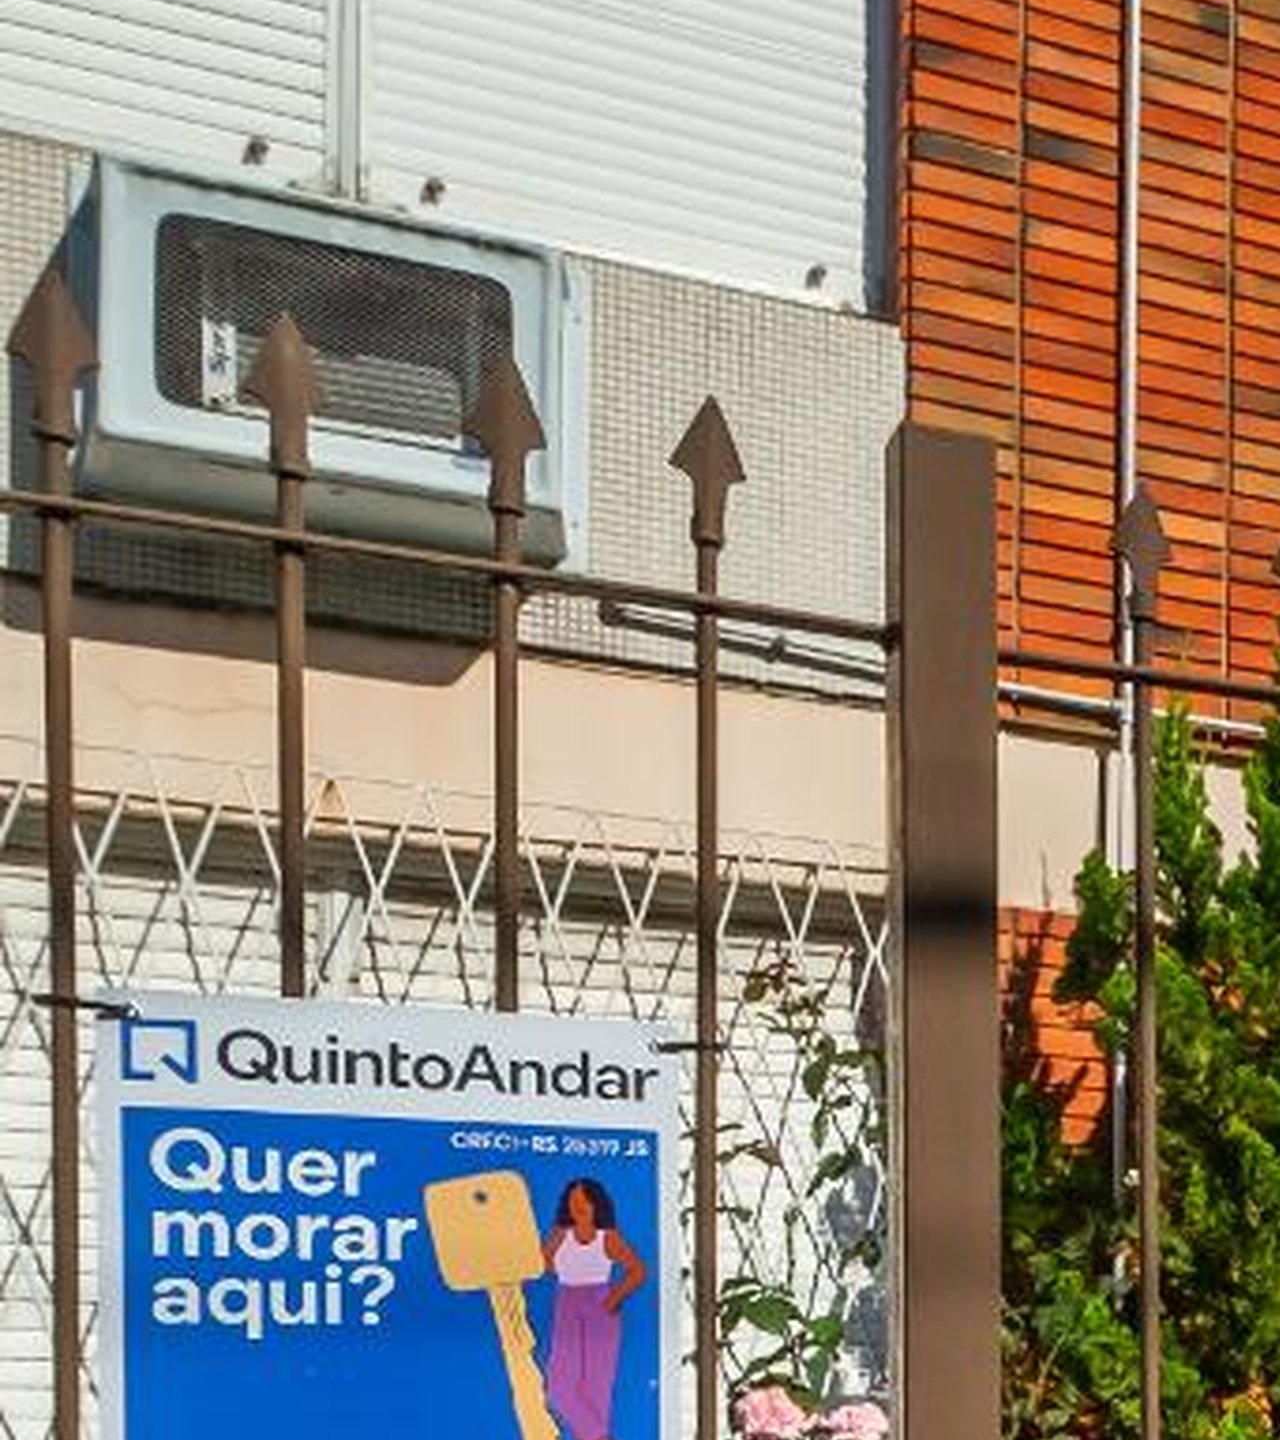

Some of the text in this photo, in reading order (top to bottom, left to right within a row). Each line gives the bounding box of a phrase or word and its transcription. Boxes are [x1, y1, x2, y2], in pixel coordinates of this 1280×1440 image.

[216, 1028, 660, 1103] QuintoAndar
[149, 1127, 376, 1197] Quer
[151, 1208, 418, 1262] morar
[151, 1264, 396, 1341] aqui?
